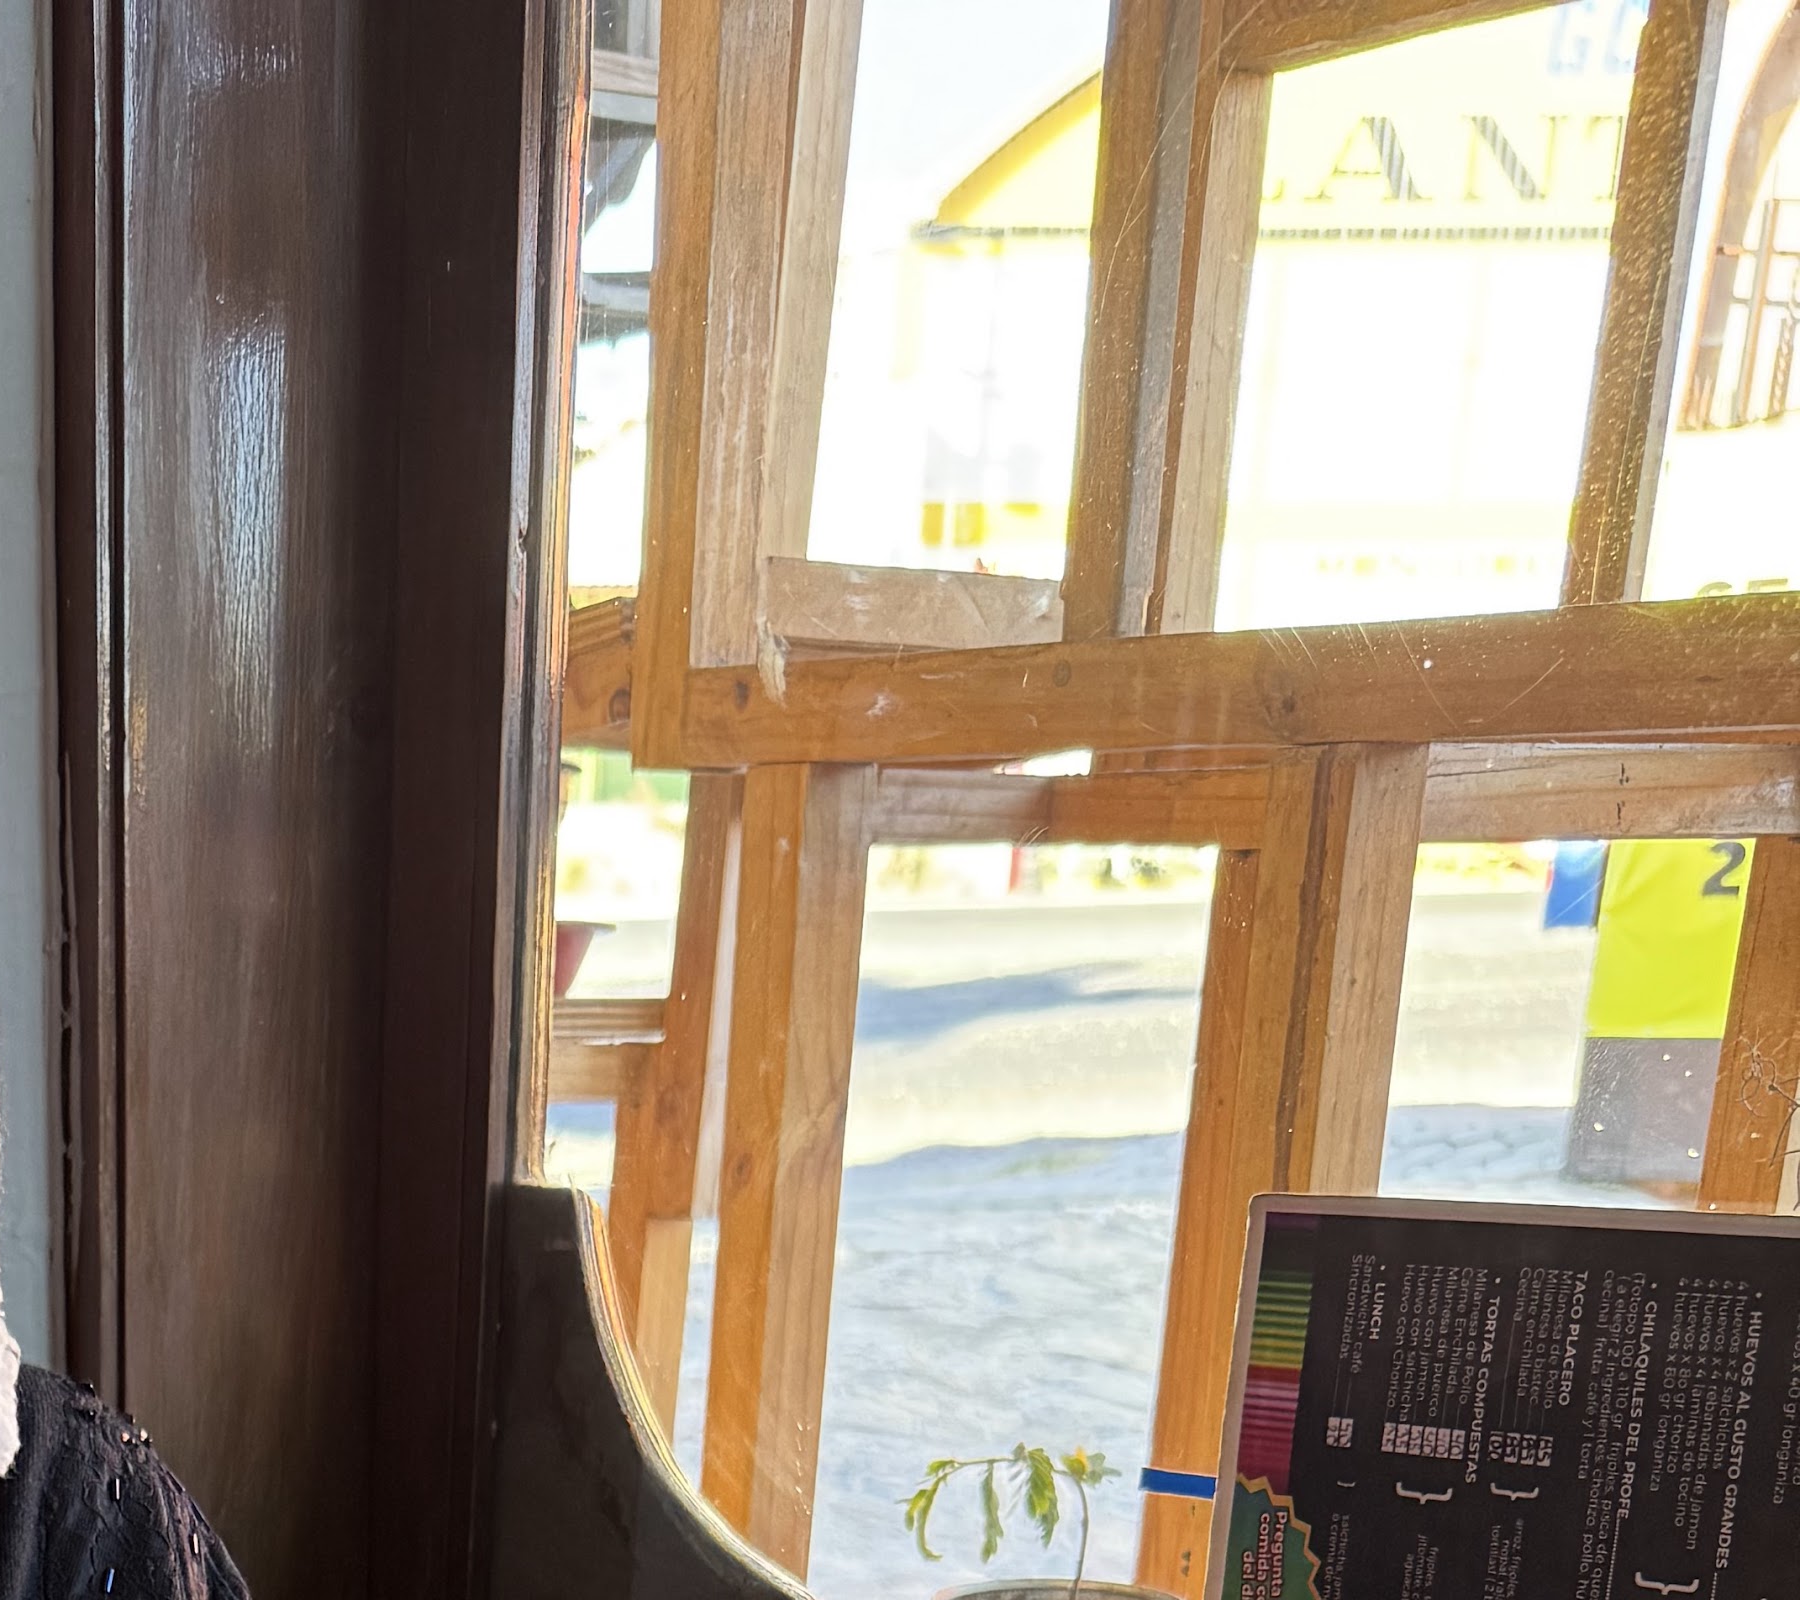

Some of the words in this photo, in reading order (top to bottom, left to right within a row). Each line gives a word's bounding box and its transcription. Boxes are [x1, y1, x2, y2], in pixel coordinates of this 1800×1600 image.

[1702, 841, 1746, 897] 2
[1338, 1253, 1362, 1360] Sincronizadas
[1367, 1282, 1386, 1340] LUNCH
[1397, 1263, 1416, 1313] Huevo
[1412, 1264, 1430, 1314] Huevo
[1425, 1265, 1444, 1315] Huevo
[1438, 1265, 1459, 1334] Milanesa
[1455, 1266, 1475, 1313] Carne
[1467, 1267, 1488, 1336] Milanesa
[1512, 1265, 1531, 1322] Cecina
[1537, 1267, 1558, 1339] Milanesa
[1551, 1268, 1573, 1340] Milanesa
[1569, 1269, 1588, 1319] TACO
[1393, 1316, 1408, 1345] con
[1407, 1316, 1422, 1347] con
[1421, 1317, 1436, 1348] con
[1434, 1338, 1450, 1359] de
[1479, 1295, 1500, 1363] TORTAS
[1606, 1298, 1626, 1344] elegir
[1667, 1291, 1688, 1350] huevos
[1682, 1292, 1703, 1351] huevos
[1698, 1293, 1717, 1352] huevos
[1712, 1294, 1733, 1353] huevos
[1727, 1294, 1748, 1354] huevos
[1738, 1310, 1763, 1386] HUEVOS
[1348, 1340, 1364, 1373] café
[1443, 1317, 1468, 1395] Enchilada
[1463, 1339, 1478, 1361] de
[1514, 1317, 1538, 1397] enchilada
[1548, 1343, 1563, 1366] de
[1557, 1322, 1581, 1406] PLACERO
[1607, 1346, 1620, 1359] 2
[1621, 1338, 1637, 1367] 100
[1628, 1300, 1658, 1418] CHILAQUILES
[1723, 1370, 1738, 1382] 2
[1385, 1348, 1405, 1409] Chorizo
[1397, 1350, 1420, 1422] salchicha
[1424, 1362, 1445, 1417] puerco
[1456, 1364, 1475, 1405] Pollo
[1541, 1369, 1560, 1409] Pollo
[1615, 1385, 1631, 1409] 110
[1656, 1391, 1672, 1409] gr
[1671, 1391, 1687, 1409] gr
[1735, 1391, 1751, 1414] AL
[1462, 1366, 1490, 1484] COMPUESTAS
[1609, 1411, 1626, 1430] gr
[1624, 1422, 1641, 1456] DEL
[1664, 1413, 1686, 1474] chorizo
[1683, 1383, 1705, 1448] laminas
[1695, 1384, 1720, 1470] rebanadas
[1711, 1385, 1736, 1470] salchichas
[1576, 1439, 1593, 1480] torta
[1645, 1414, 1669, 1491] longaniza
[1680, 1450, 1695, 1473] de
[1725, 1418, 1748, 1480] GUSTO
[1770, 1424, 1796, 1505] longaniza
[1615, 1460, 1636, 1519] PROFE
[1672, 1475, 1692, 1527] tocino
[1691, 1472, 1706, 1496] de
[1251, 1511, 1275, 1582] comida
[1265, 1510, 1291, 1597] Pregunta
[1594, 1542, 1609, 1564] de
[1714, 1483, 1739, 1569] GRANDES
[1238, 1550, 1256, 1580] del
